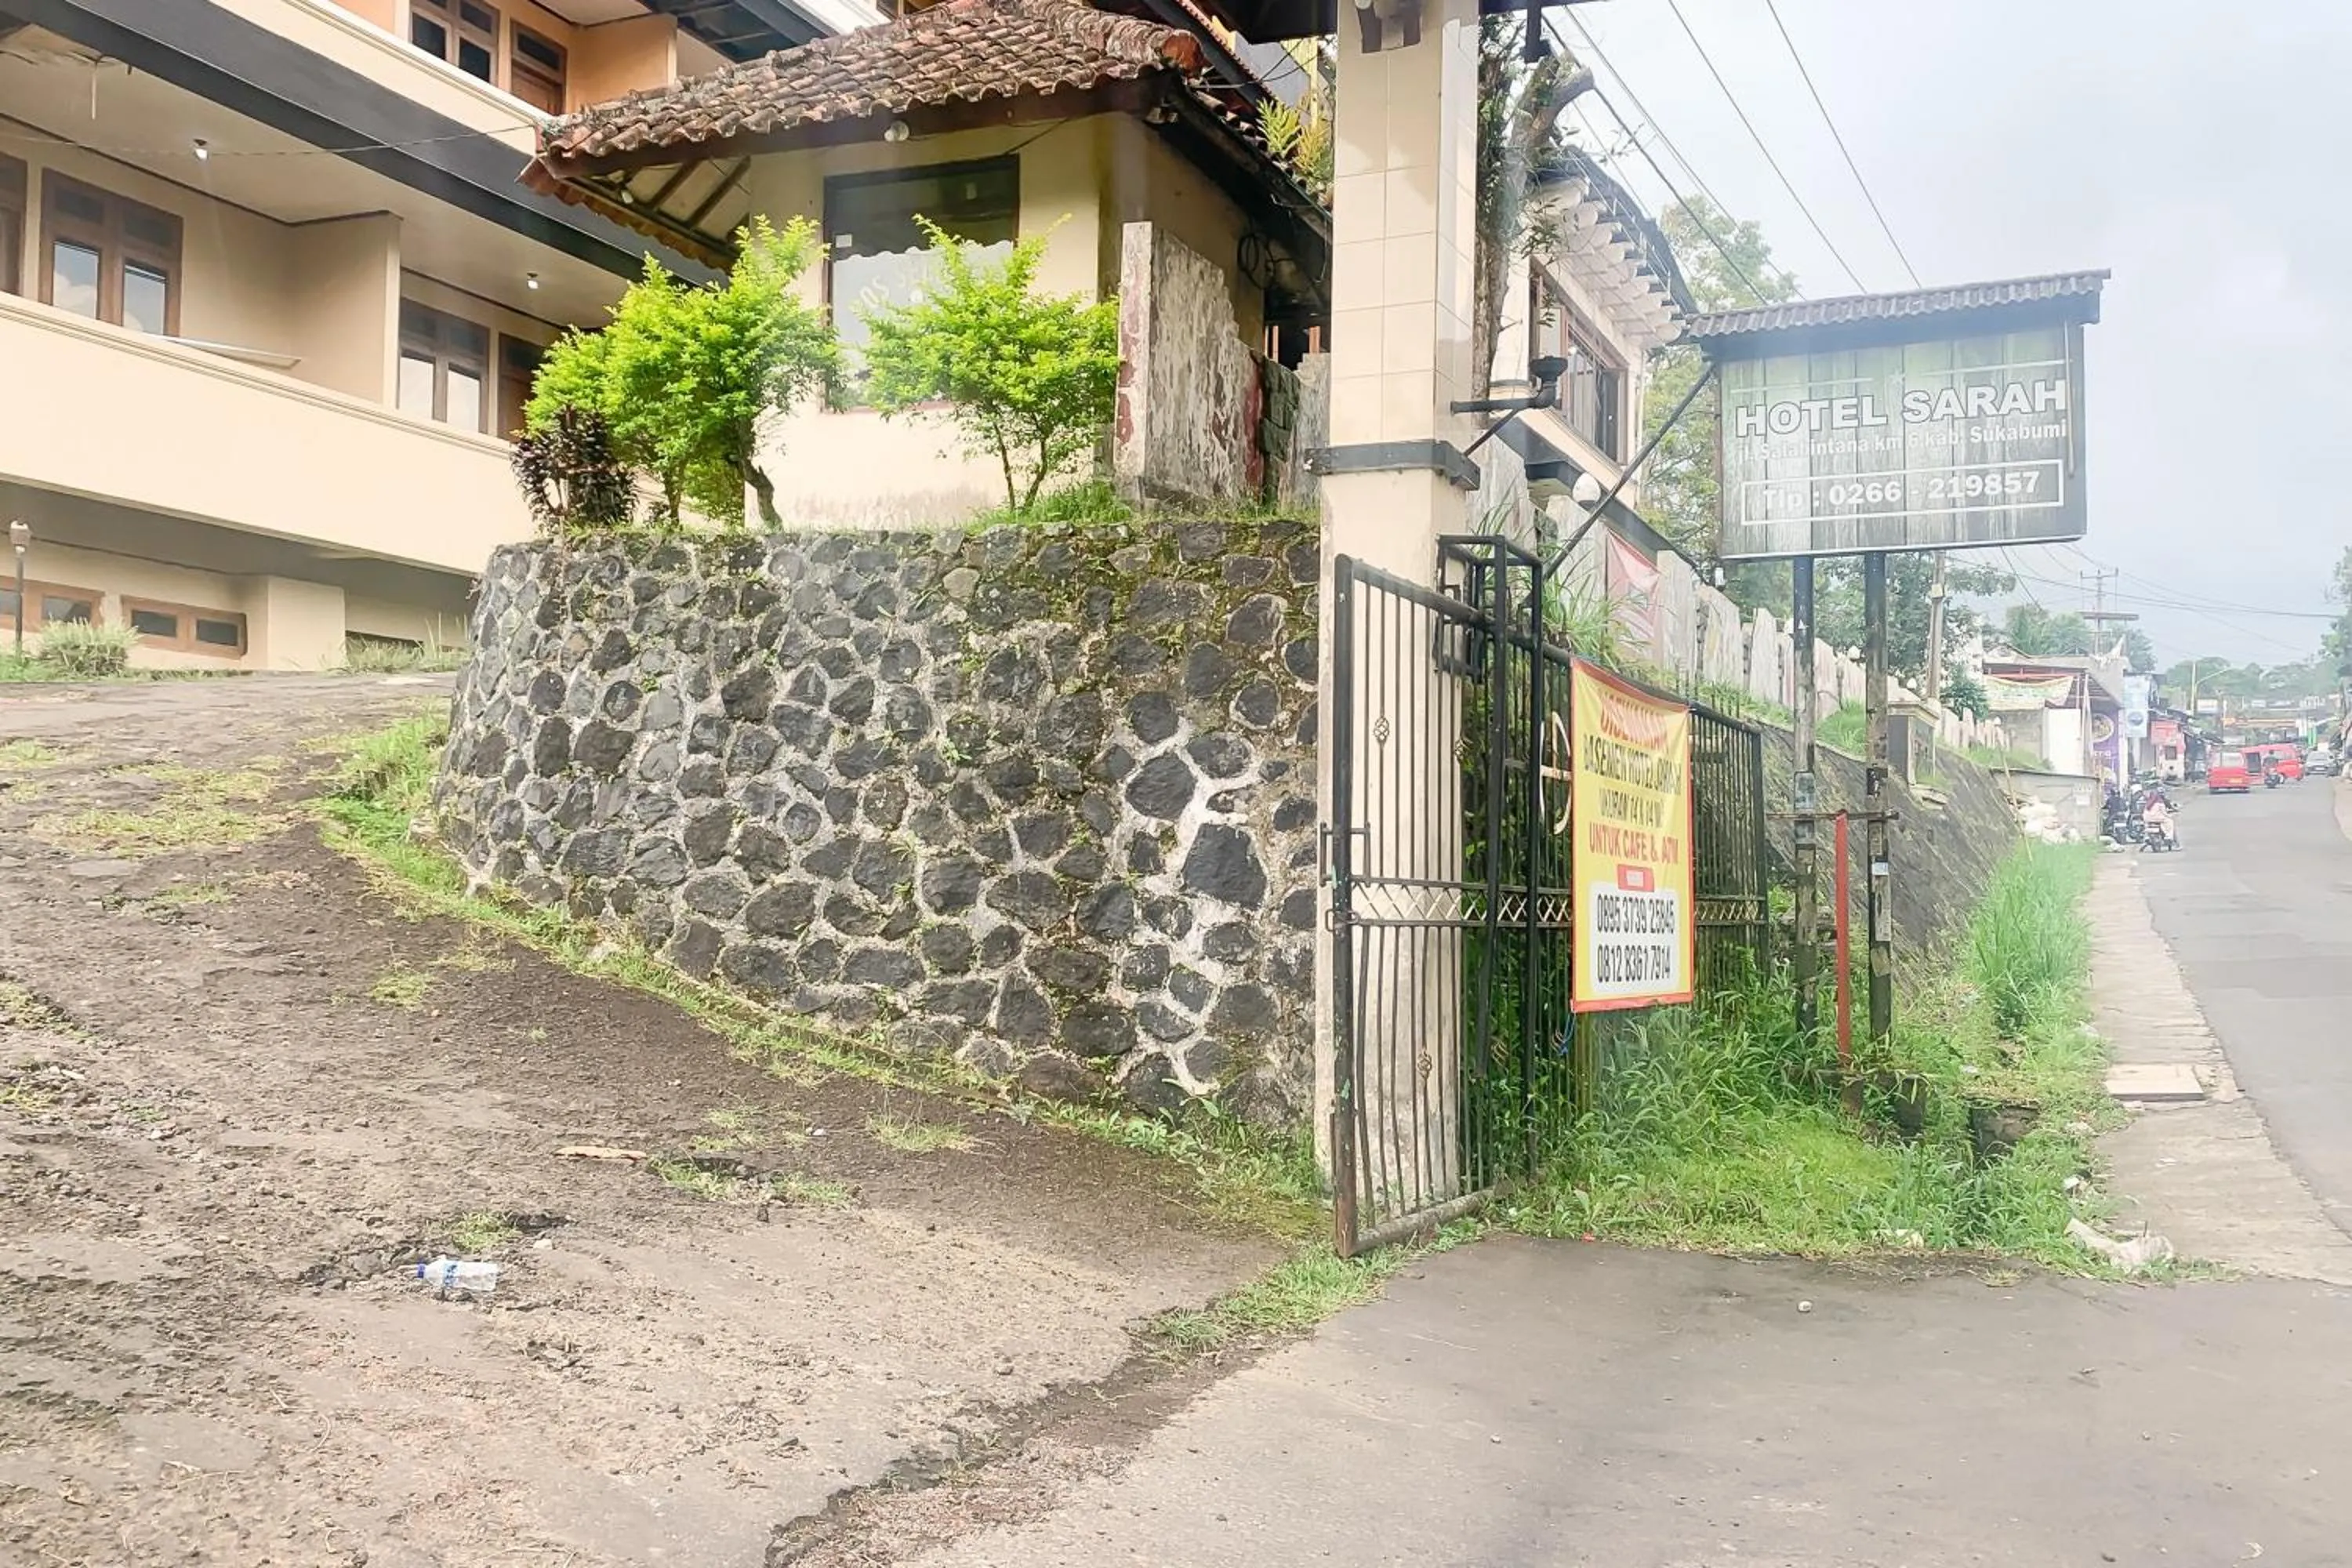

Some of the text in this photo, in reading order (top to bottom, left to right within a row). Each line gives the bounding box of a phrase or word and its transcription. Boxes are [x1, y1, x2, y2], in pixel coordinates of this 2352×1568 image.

[1735, 379, 2067, 437] HOTEL SARAH
[1875, 436, 1902, 451] km
[1970, 419, 2067, 443] Sukabumi
[1829, 481, 1901, 506] 0266
[1927, 470, 2040, 499] 219857
[1589, 821, 1621, 857] UNTUK
[1623, 829, 1647, 862] CAFE
[1661, 836, 1679, 866] ATM
[1622, 896, 1647, 934] 3739
[1597, 944, 1622, 983] 0812
